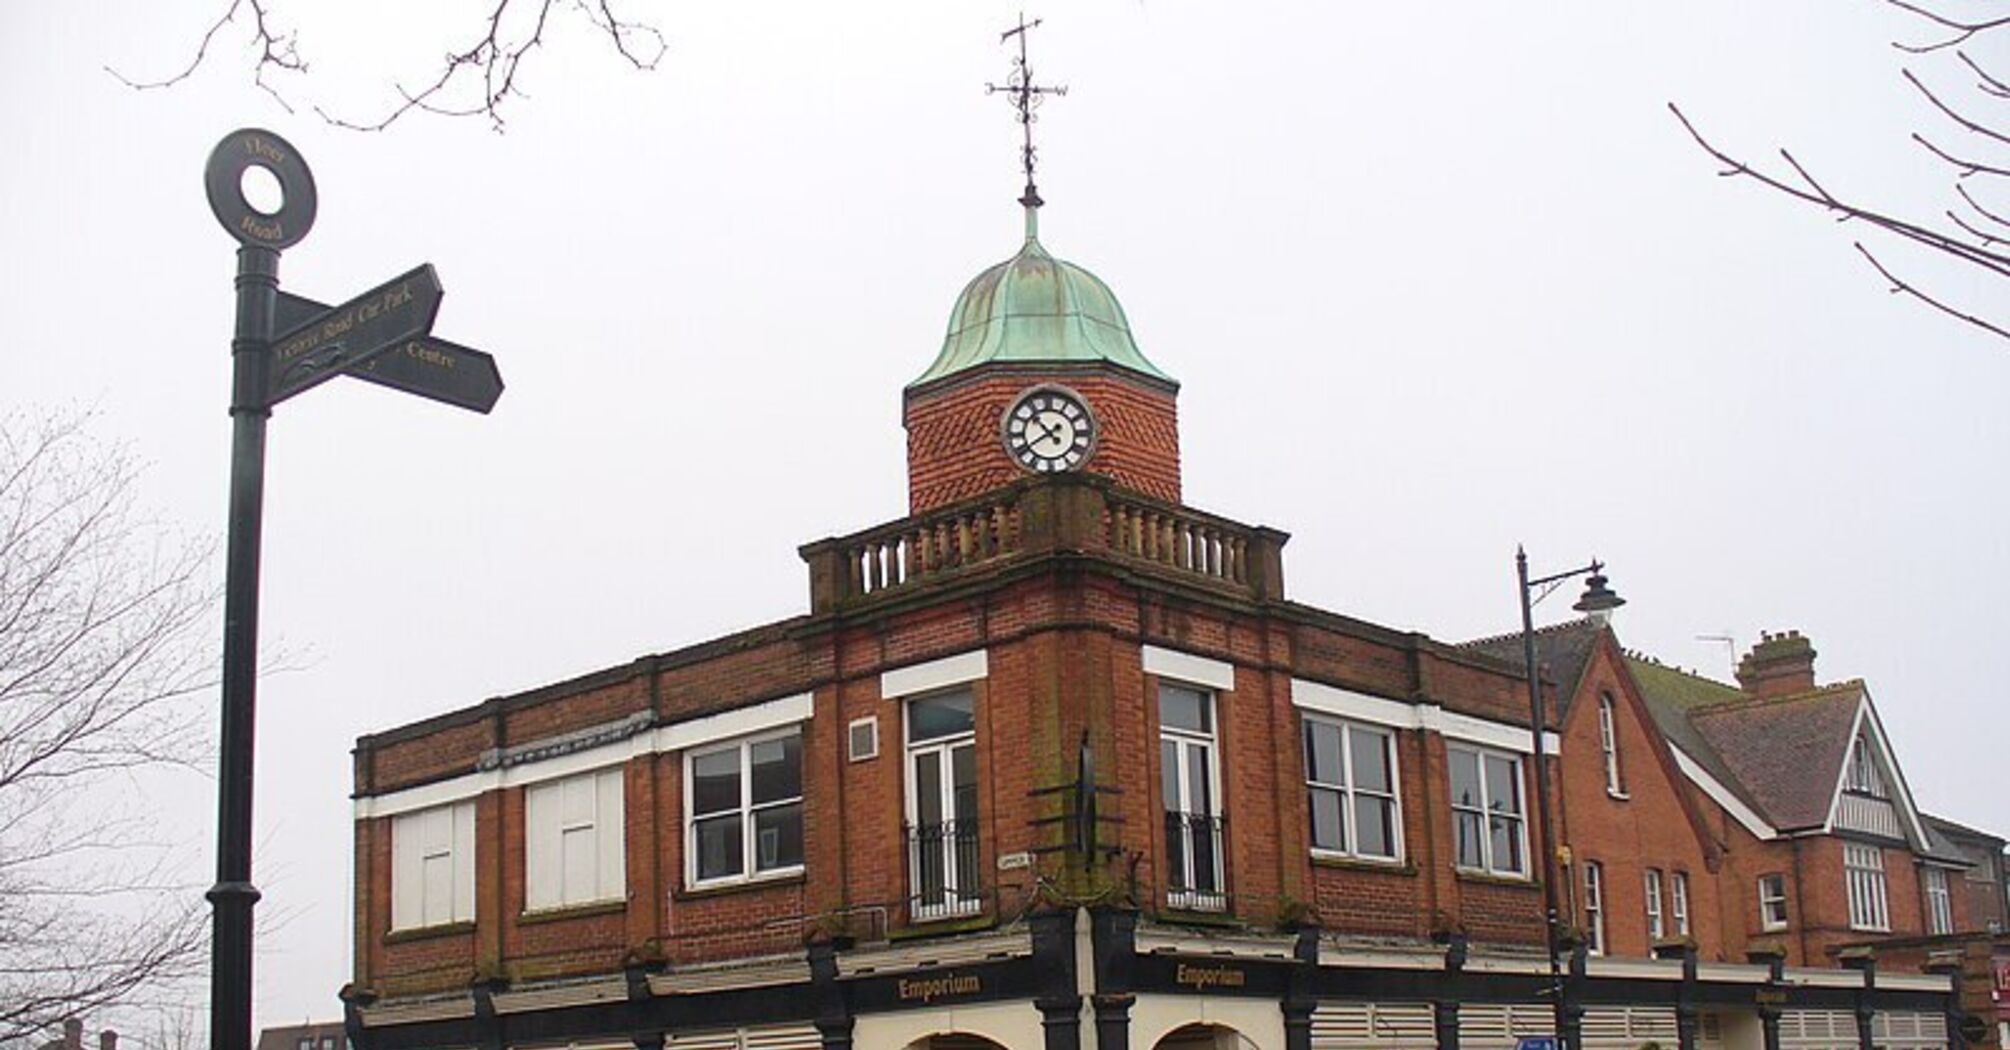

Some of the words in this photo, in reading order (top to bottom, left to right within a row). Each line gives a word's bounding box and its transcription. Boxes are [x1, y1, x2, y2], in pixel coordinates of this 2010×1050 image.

[240, 215, 283, 240] Road
[383, 283, 414, 311] Park
[406, 340, 457, 369] Centre
[899, 972, 981, 1002] Emporium
[1176, 963, 1245, 990] Emporium
